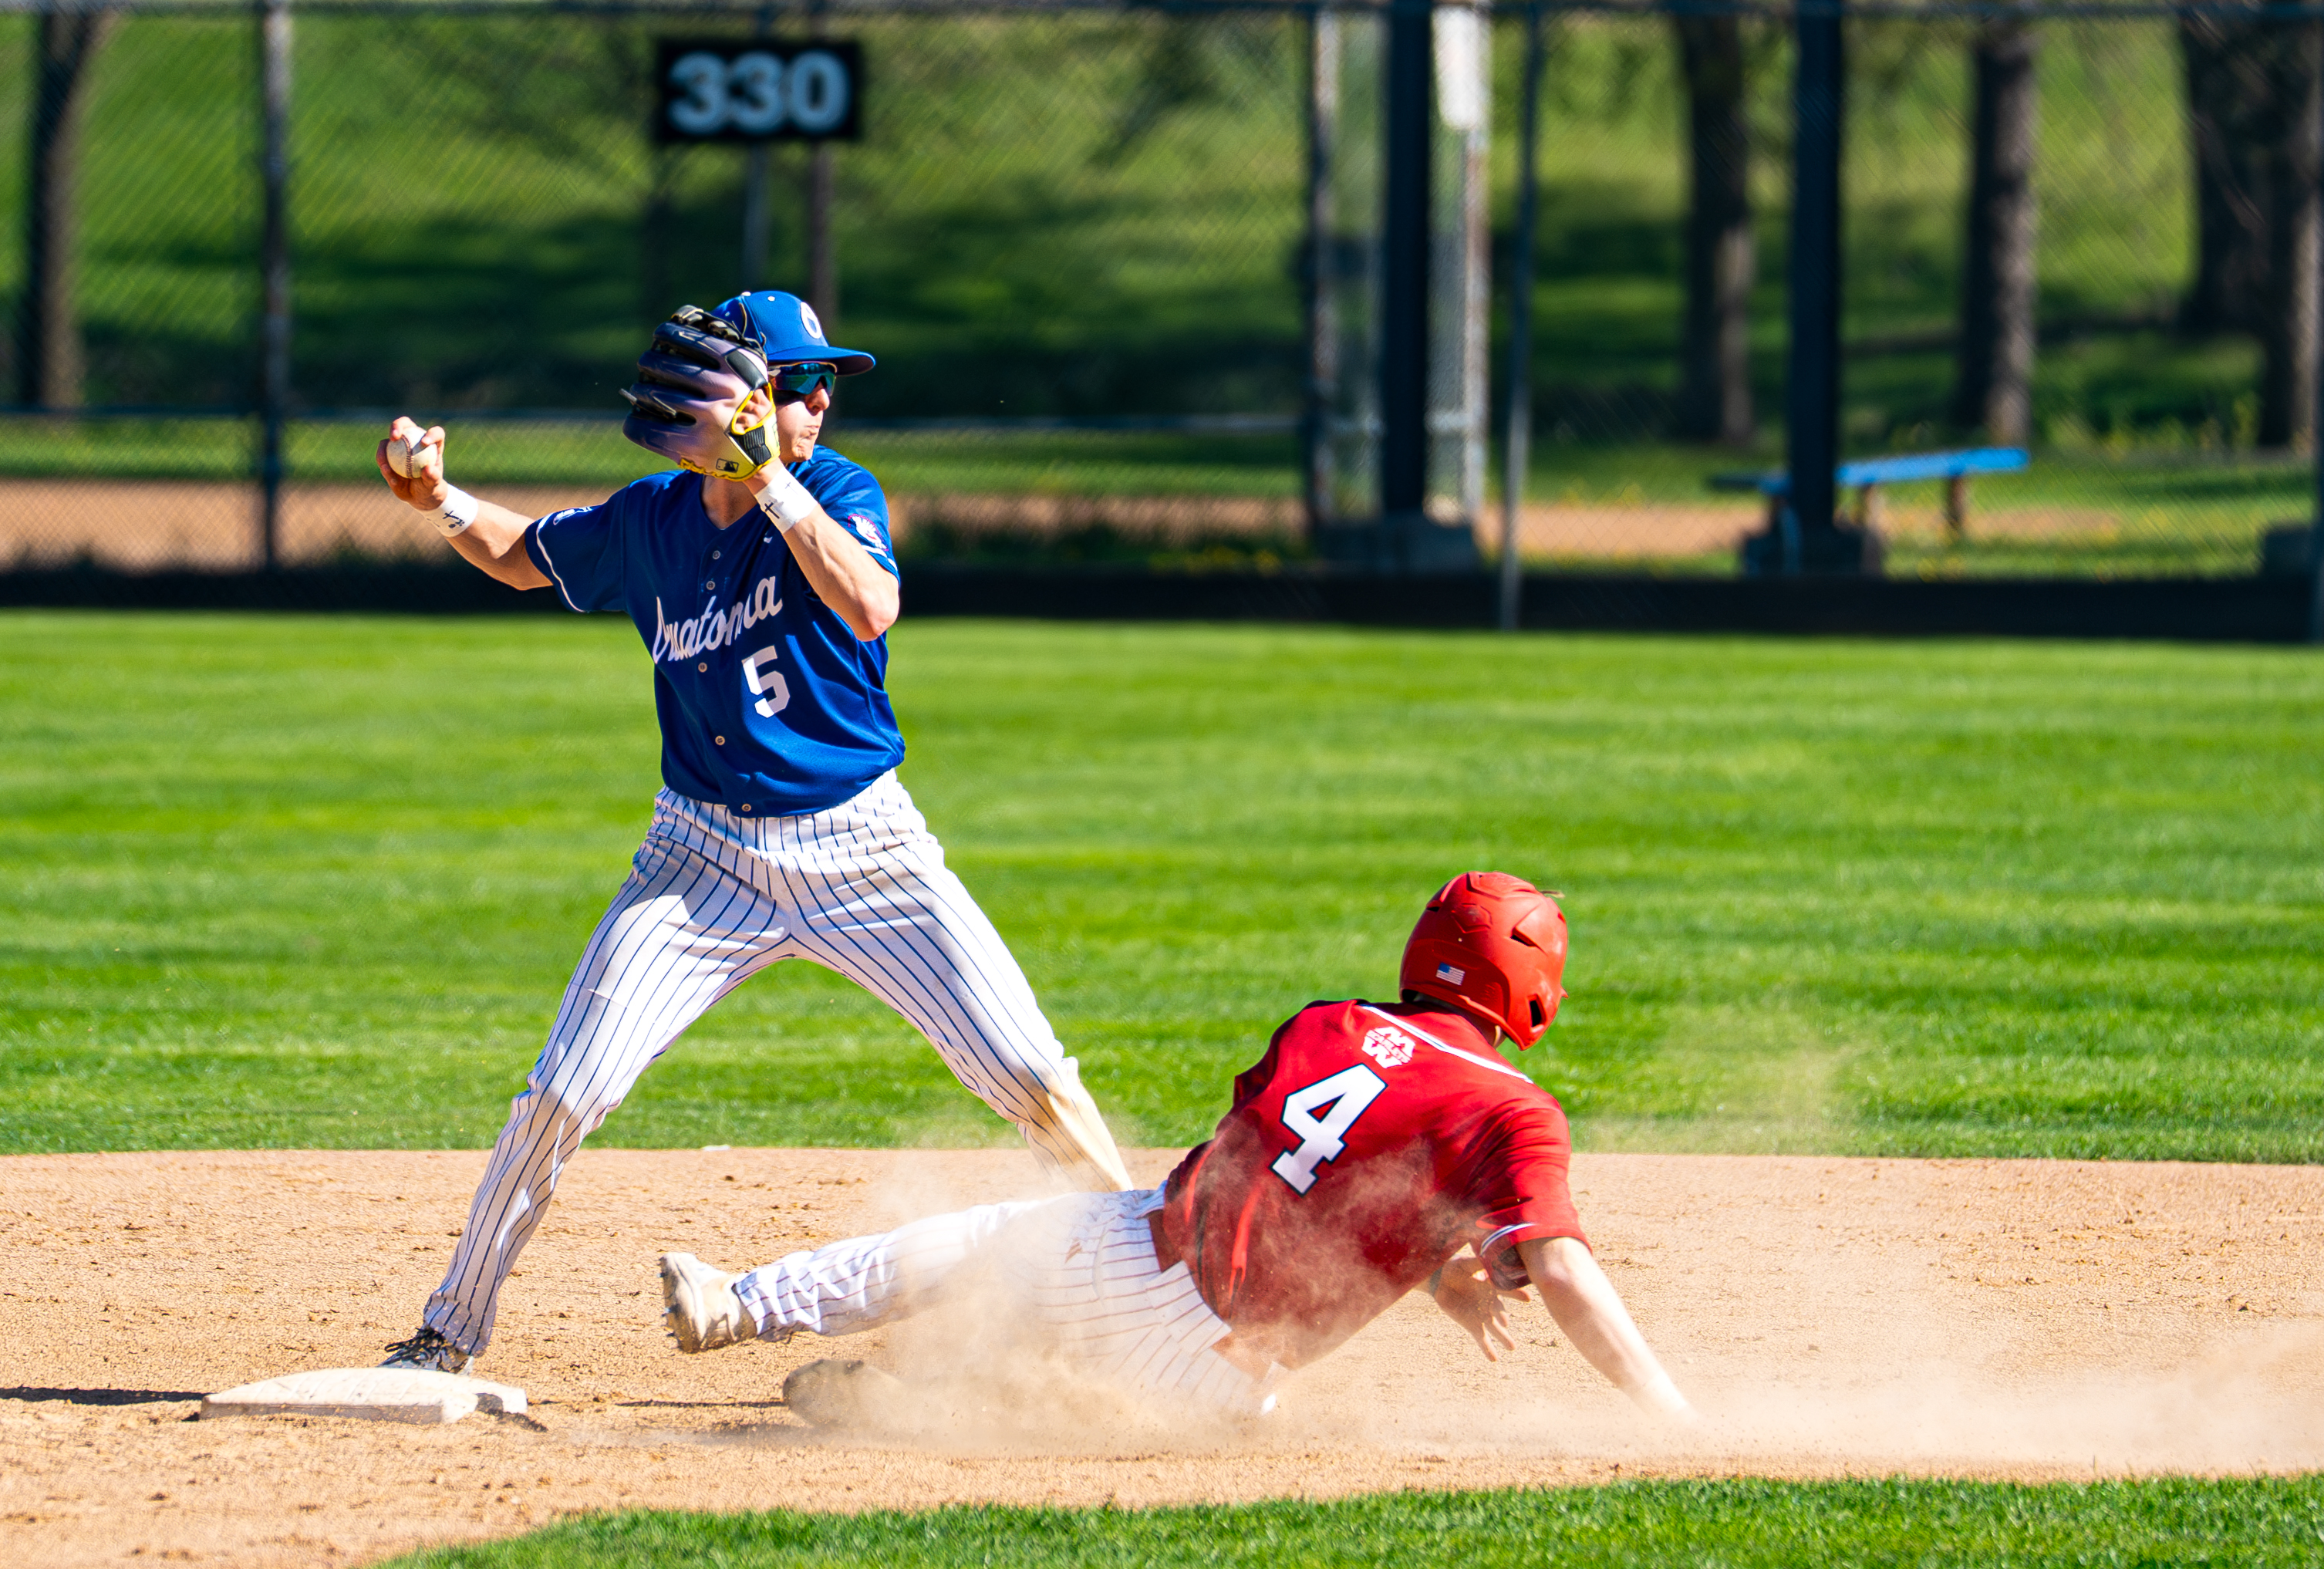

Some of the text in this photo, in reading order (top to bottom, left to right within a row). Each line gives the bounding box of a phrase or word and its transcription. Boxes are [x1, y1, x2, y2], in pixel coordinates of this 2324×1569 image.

[669, 50, 850, 133] 330
[741, 645, 791, 718] 5
[1269, 1063, 1388, 1197] 4
